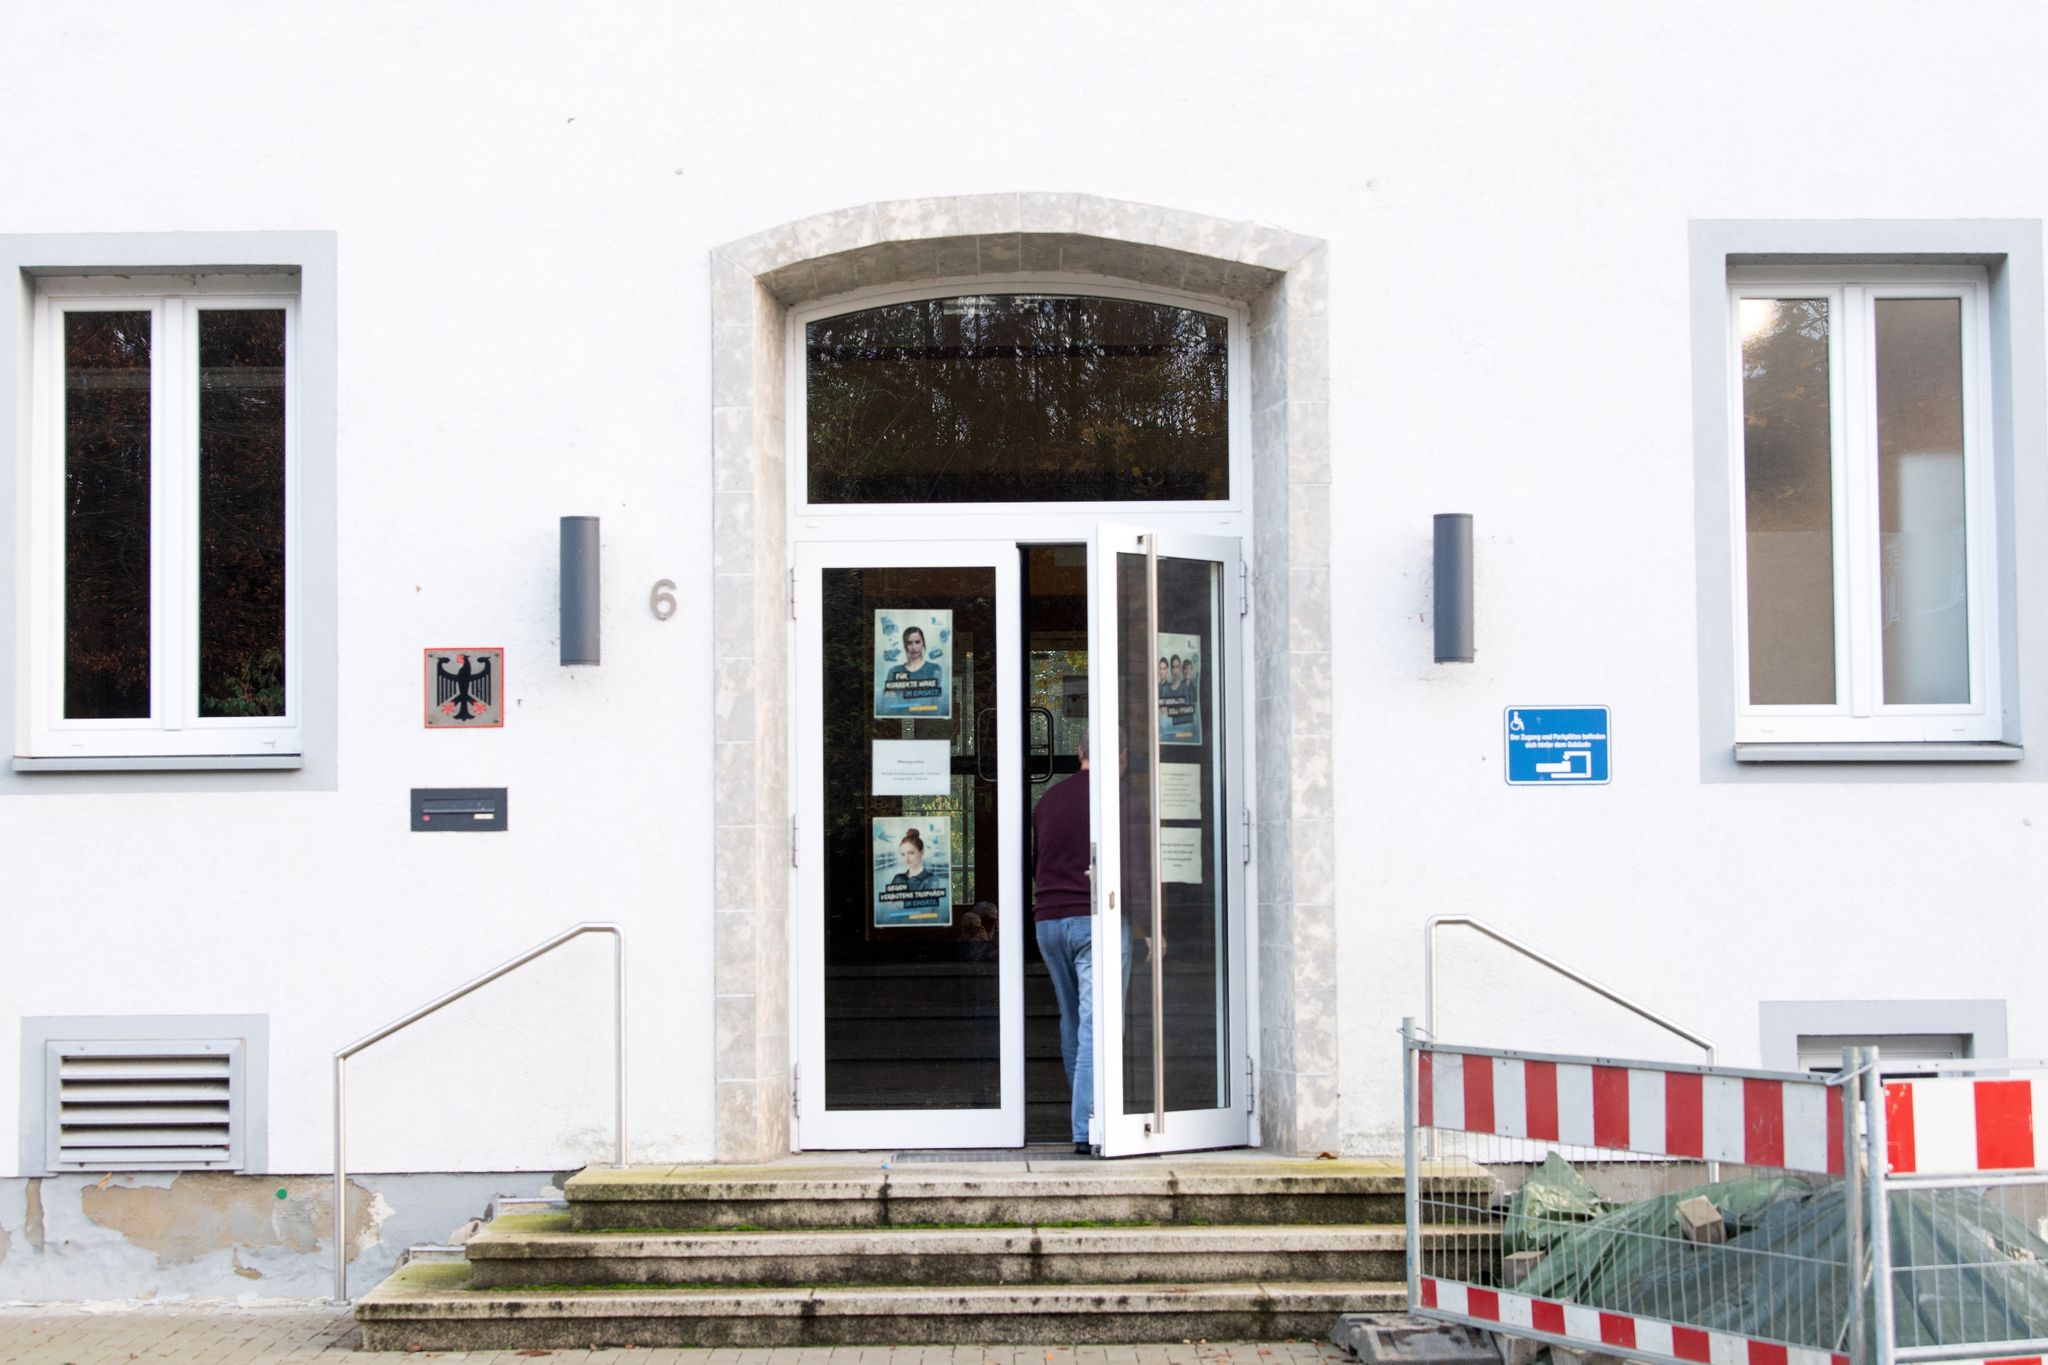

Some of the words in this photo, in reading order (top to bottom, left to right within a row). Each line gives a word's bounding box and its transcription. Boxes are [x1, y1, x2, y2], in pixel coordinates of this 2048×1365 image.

[650, 579, 677, 621] 6
[1521, 733, 1541, 742] Zugang
[1553, 733, 1582, 741] Parkplätze
